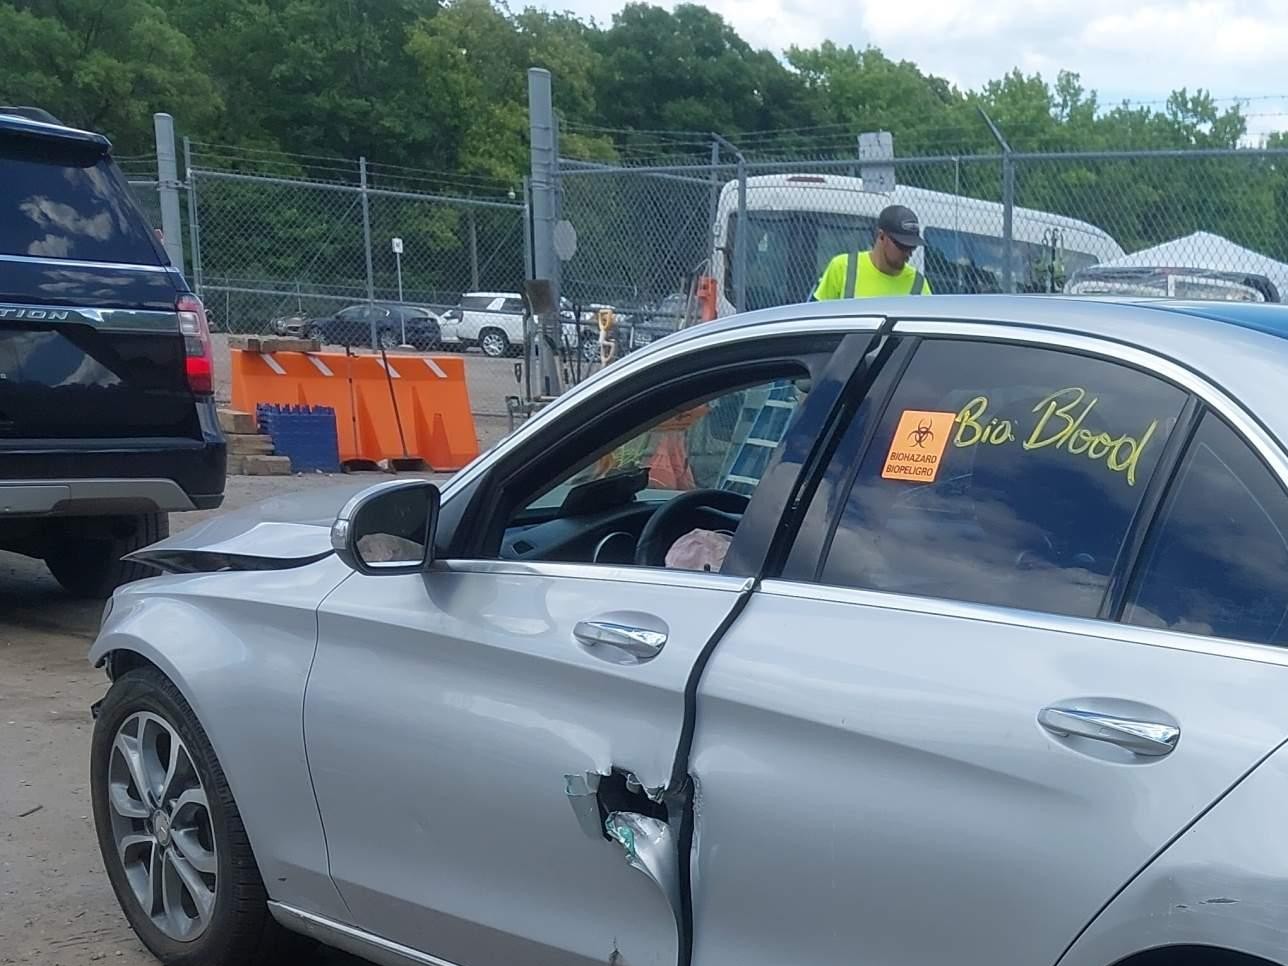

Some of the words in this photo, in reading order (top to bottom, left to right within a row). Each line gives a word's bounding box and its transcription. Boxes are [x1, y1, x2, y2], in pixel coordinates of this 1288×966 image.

[1022, 387, 1159, 487] Blood
[889, 452, 938, 464] BIOHAZARD
[885, 465, 934, 477] BIOPELIGRO
